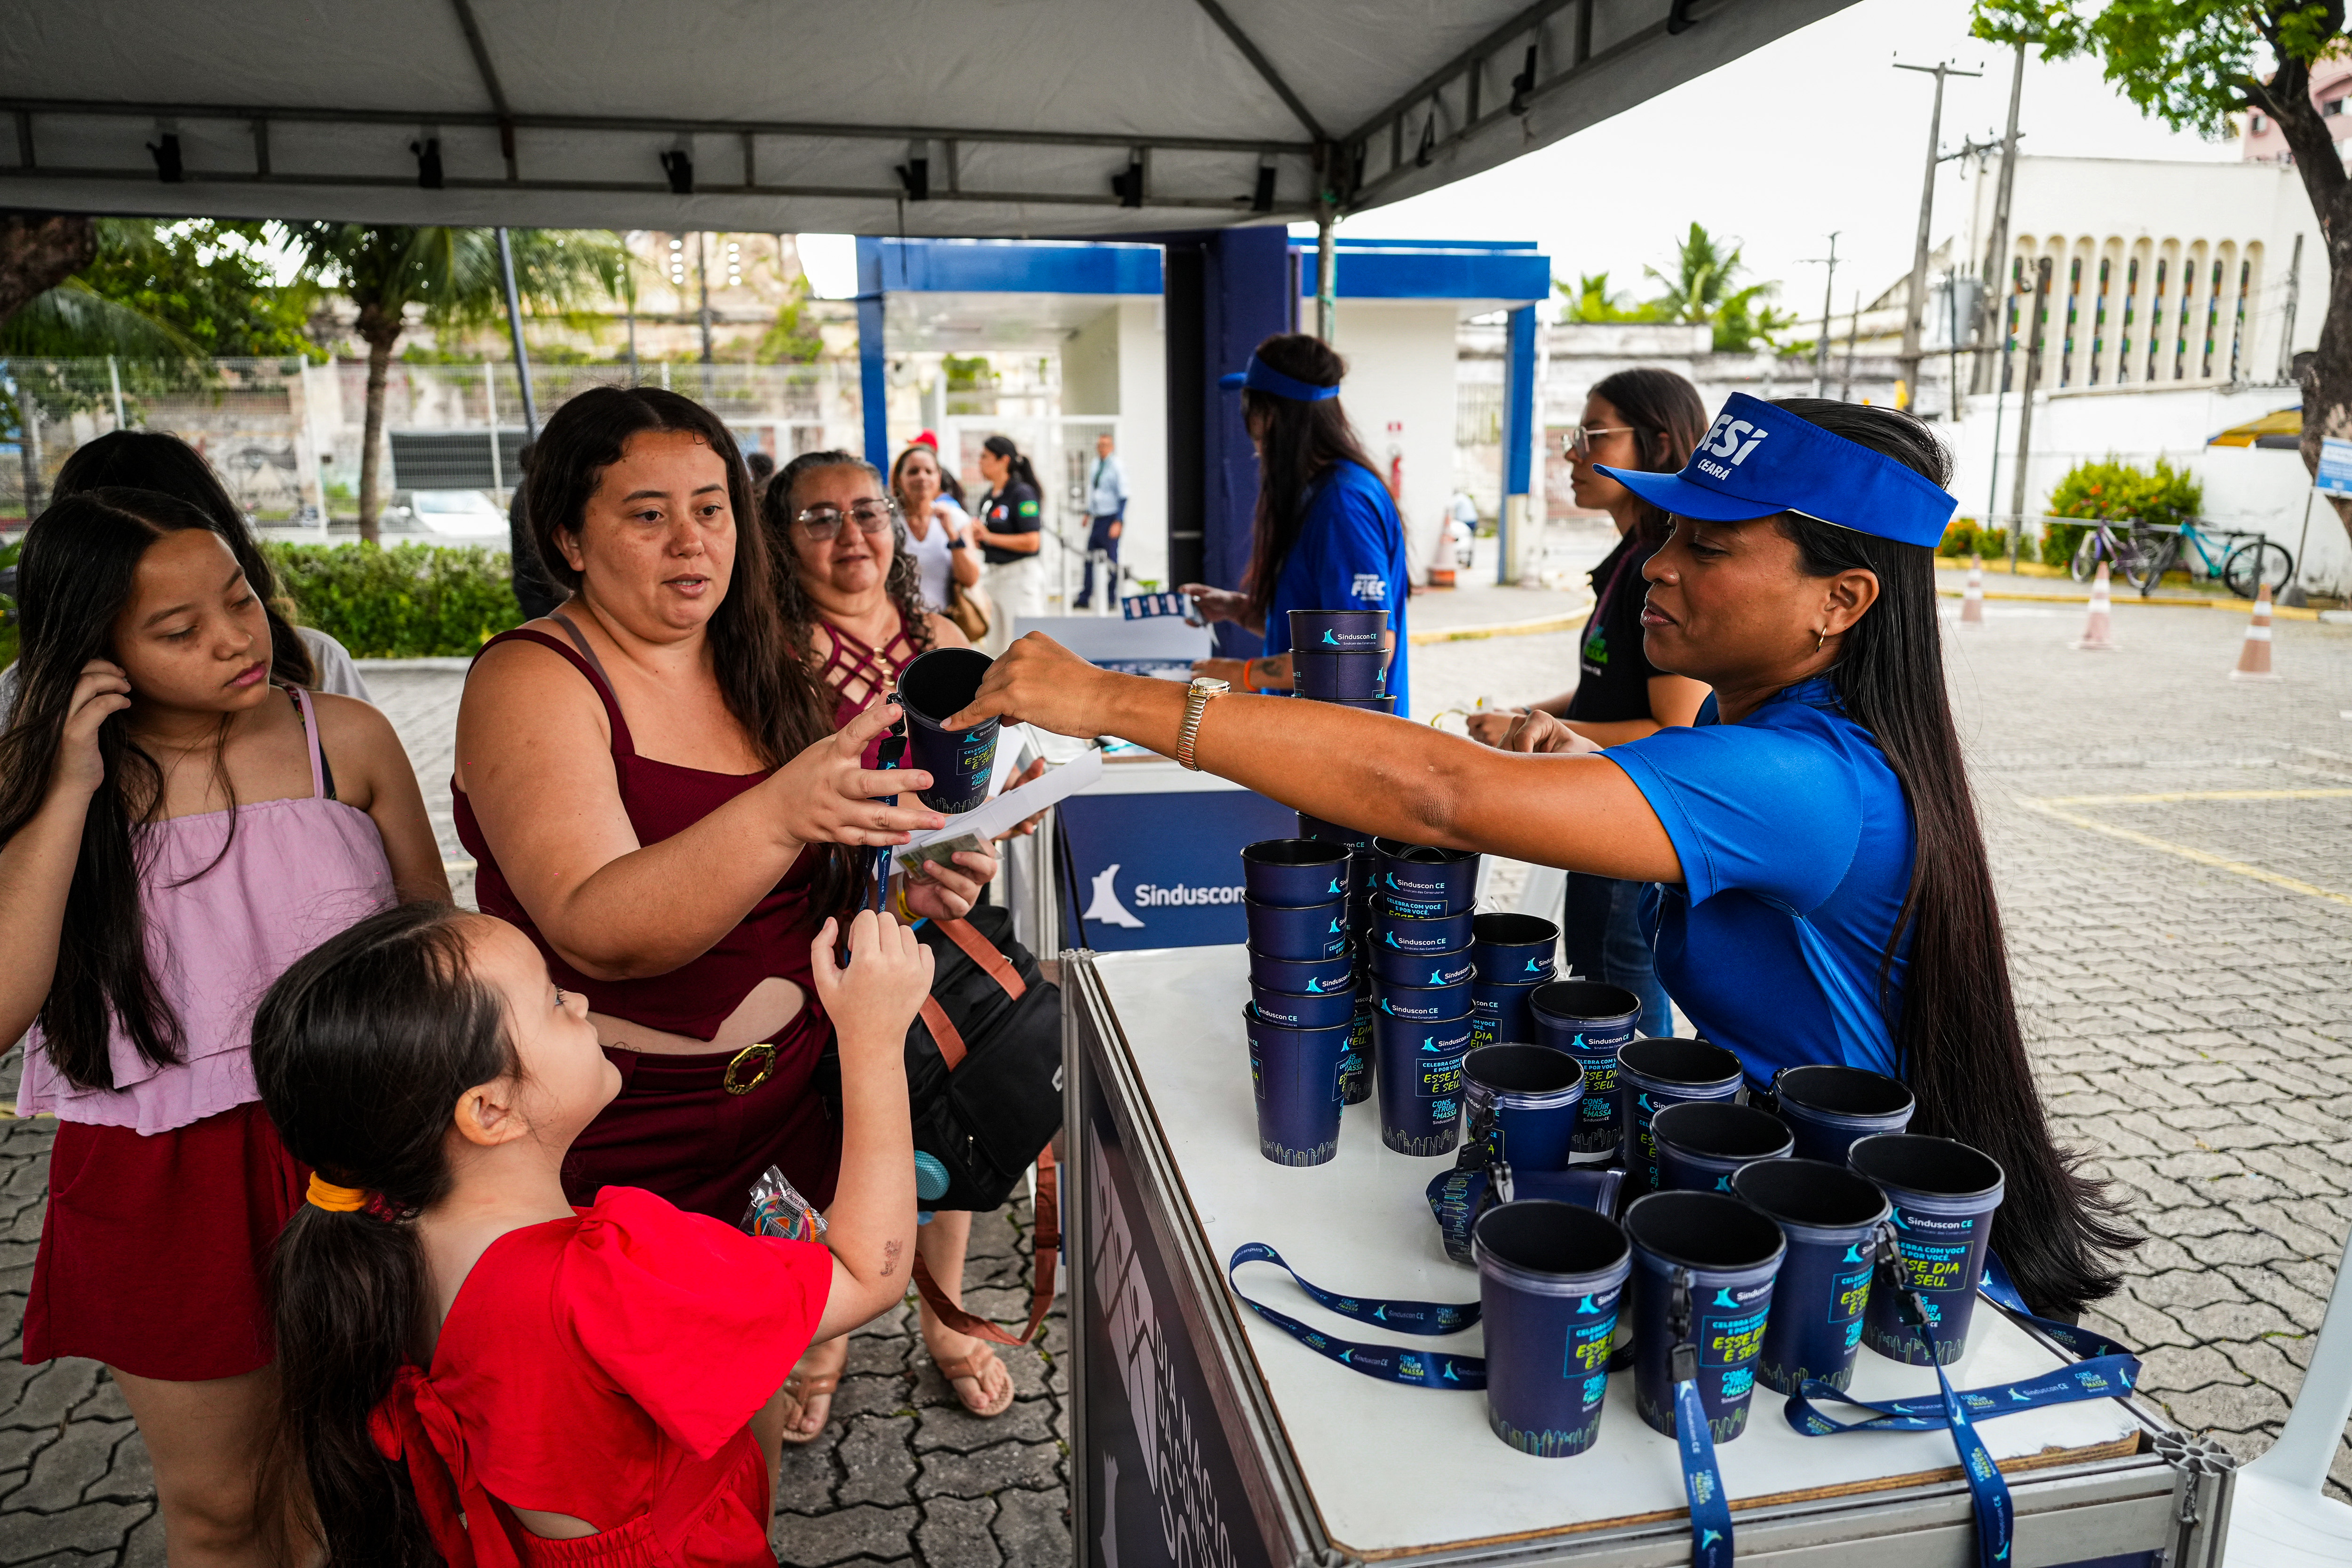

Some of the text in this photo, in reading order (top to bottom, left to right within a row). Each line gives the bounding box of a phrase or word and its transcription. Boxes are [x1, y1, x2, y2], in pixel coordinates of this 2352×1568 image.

[1698, 459, 1732, 480] CEARÁ
[964, 743, 987, 755] CELEBRA
[965, 749, 989, 765] ESSE
[1398, 879, 1434, 889] Sinduscon
[1135, 883, 1245, 907] Sinduscon
[1387, 897, 1409, 908] CELEBRA
[1445, 966, 1469, 979] Sinduscon
[1322, 974, 1348, 987] Sinduscon
[1258, 1006, 1287, 1020] Sinduscon
[1392, 1005, 1428, 1014] Sinduscon
[1358, 1026, 1372, 1036] DIA
[1474, 1030, 1493, 1042] DIA
[1352, 1037, 1367, 1045] EU.
[1438, 1035, 1467, 1047] Sinduscon
[1424, 1072, 1451, 1083] ESSE
[1432, 1080, 1460, 1093] É SEU.
[1593, 1080, 1615, 1090] SEU.
[1432, 1098, 1451, 1107] CONS
[1438, 1103, 1456, 1113] TRUIR
[1437, 1108, 1457, 1120] MASSA
[1587, 1108, 1611, 1117] MASSA
[789, 1195, 799, 1204] ALTO
[777, 1204, 798, 1222] ADICIONADO
[1907, 1216, 1973, 1229] Sinduscon CE
[1907, 1250, 1925, 1259] POR
[1945, 1246, 1965, 1255] VOCÊ
[1932, 1262, 1960, 1275] DIA
[1914, 1274, 1947, 1287] SEU.
[1388, 1310, 1416, 1319] Sinduscon
[1712, 1318, 1749, 1329] CELEBRA
[1713, 1331, 1752, 1350] ESSE
[1353, 1354, 1388, 1367] Sinduscon CE
[1156, 1316, 1177, 1422] DIA
[1402, 1368, 1424, 1376] MASSA
[2074, 1370, 2092, 1379] CONS
[2023, 1385, 2058, 1396] Sinduscon
[1158, 1377, 1173, 1461] DA
